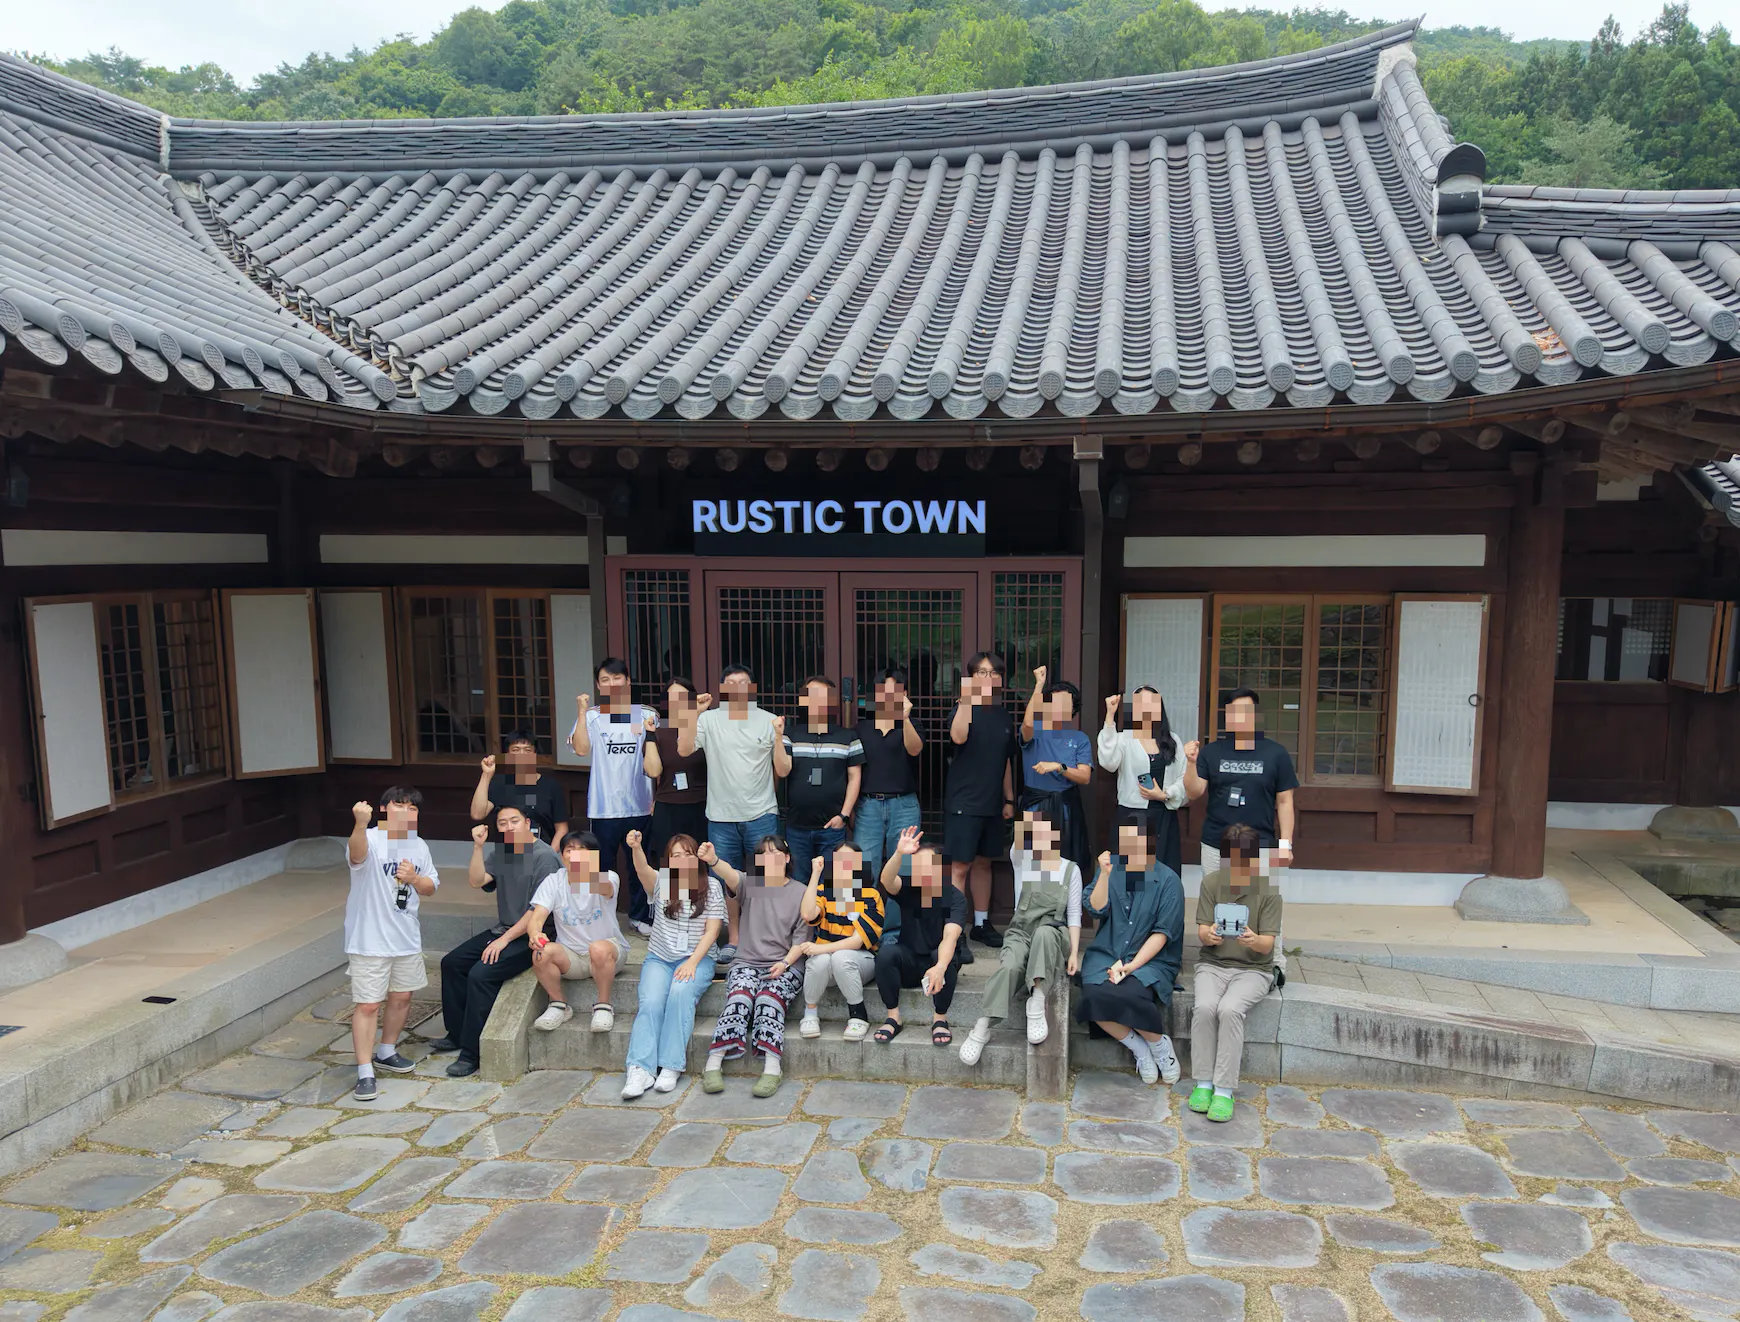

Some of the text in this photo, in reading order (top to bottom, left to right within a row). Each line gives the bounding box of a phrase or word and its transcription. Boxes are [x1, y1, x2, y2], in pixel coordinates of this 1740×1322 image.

[692, 500, 986, 534] RUSTIC TOWN
[1222, 761, 1262, 771] OAKLEY
